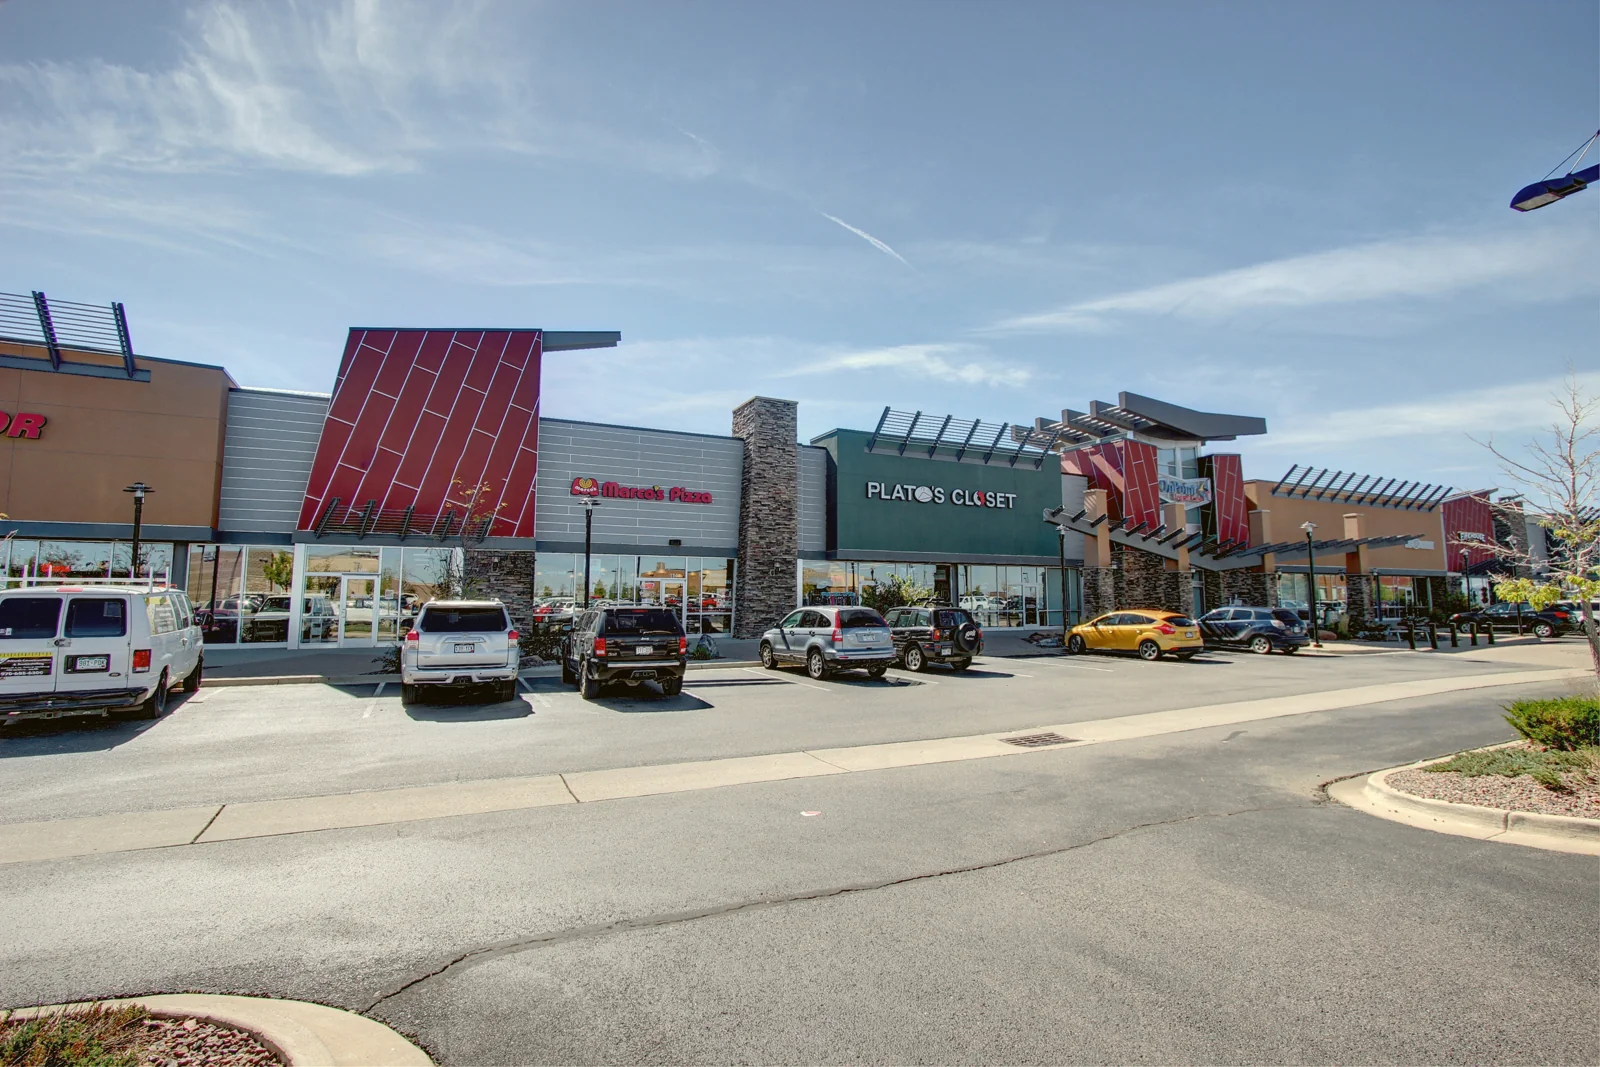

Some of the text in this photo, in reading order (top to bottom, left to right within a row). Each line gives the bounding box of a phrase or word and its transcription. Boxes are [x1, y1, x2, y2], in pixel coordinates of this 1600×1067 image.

[602, 481, 713, 504] Marco's Pizza
[866, 481, 1017, 509] PLATO'S CLOSET
